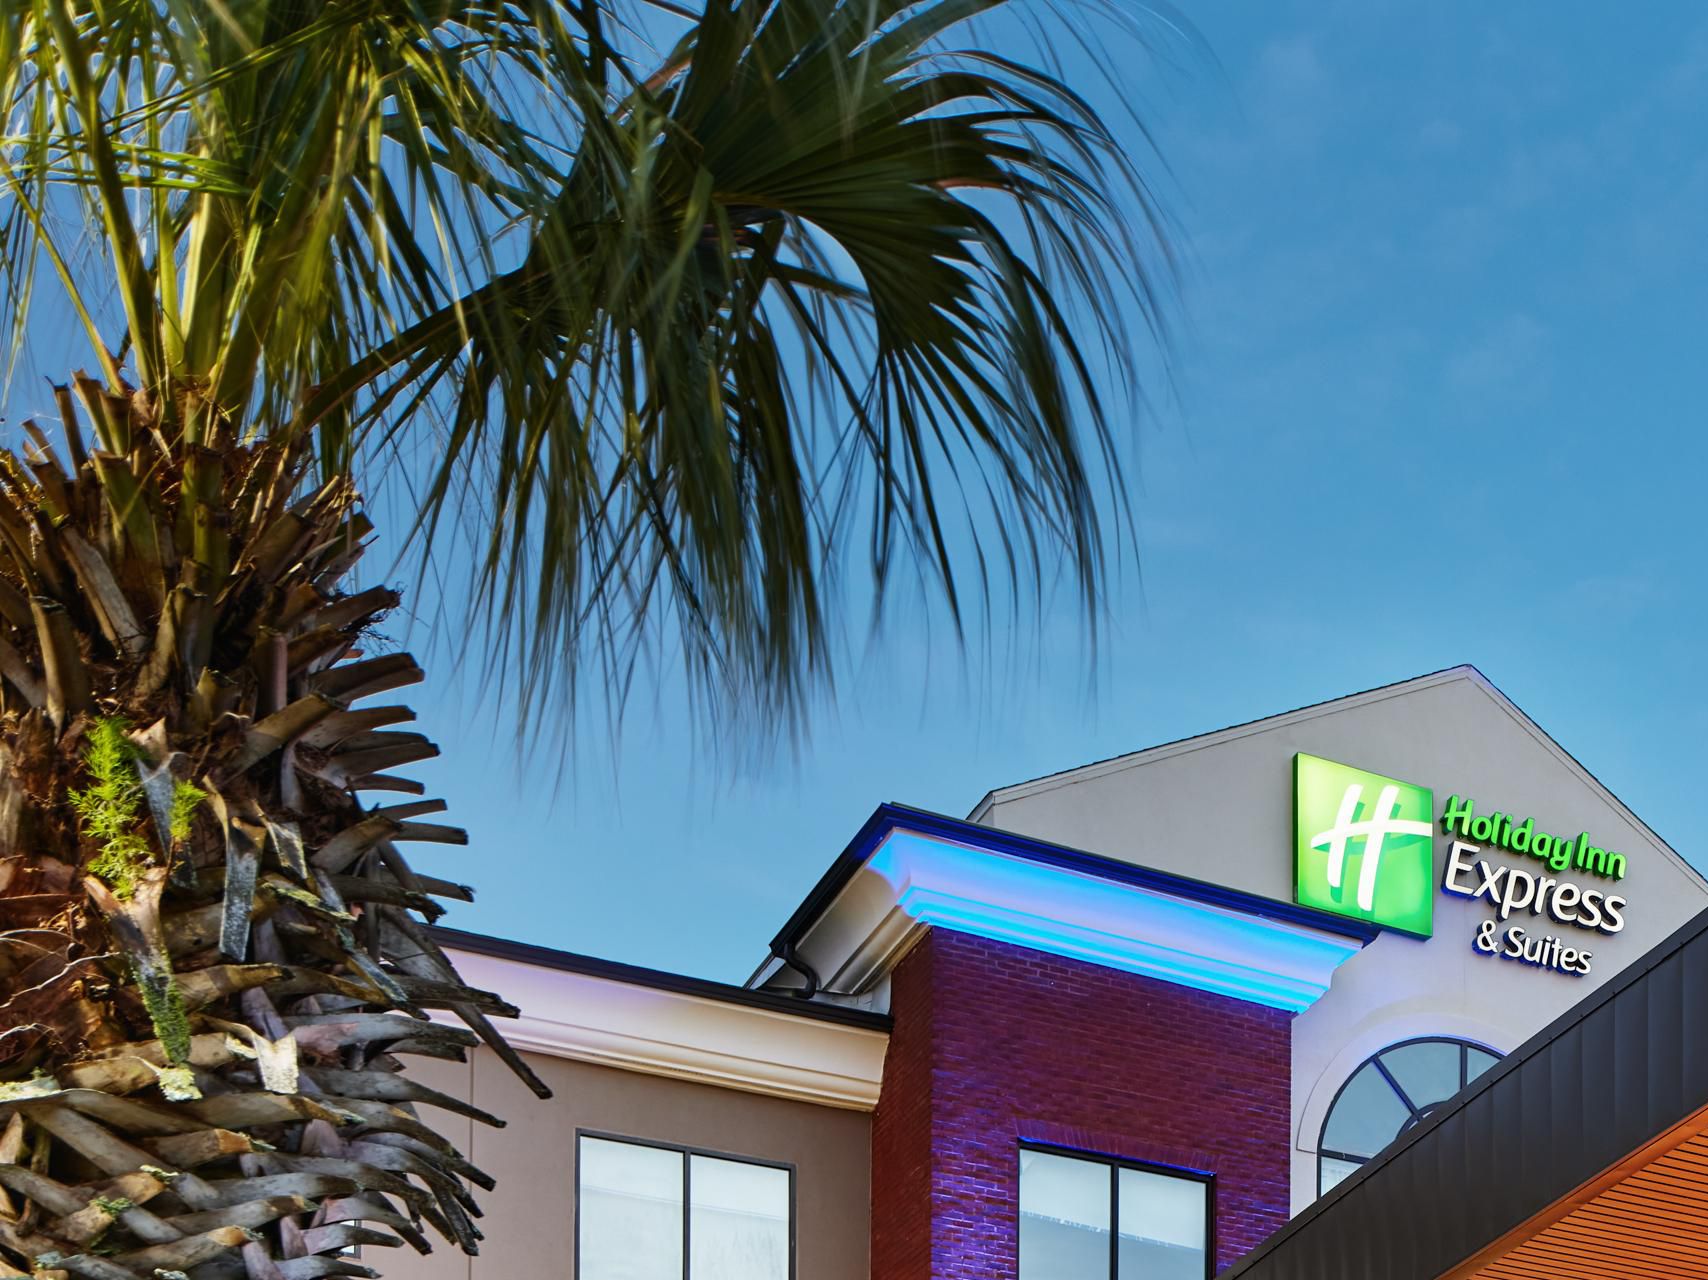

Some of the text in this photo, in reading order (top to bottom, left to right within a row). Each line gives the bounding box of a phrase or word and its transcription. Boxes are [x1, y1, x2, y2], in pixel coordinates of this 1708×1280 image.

[1443, 794, 1628, 880] Holiday Inn
[1445, 840, 1628, 933] Express
[1476, 919, 1593, 975] & Suites
